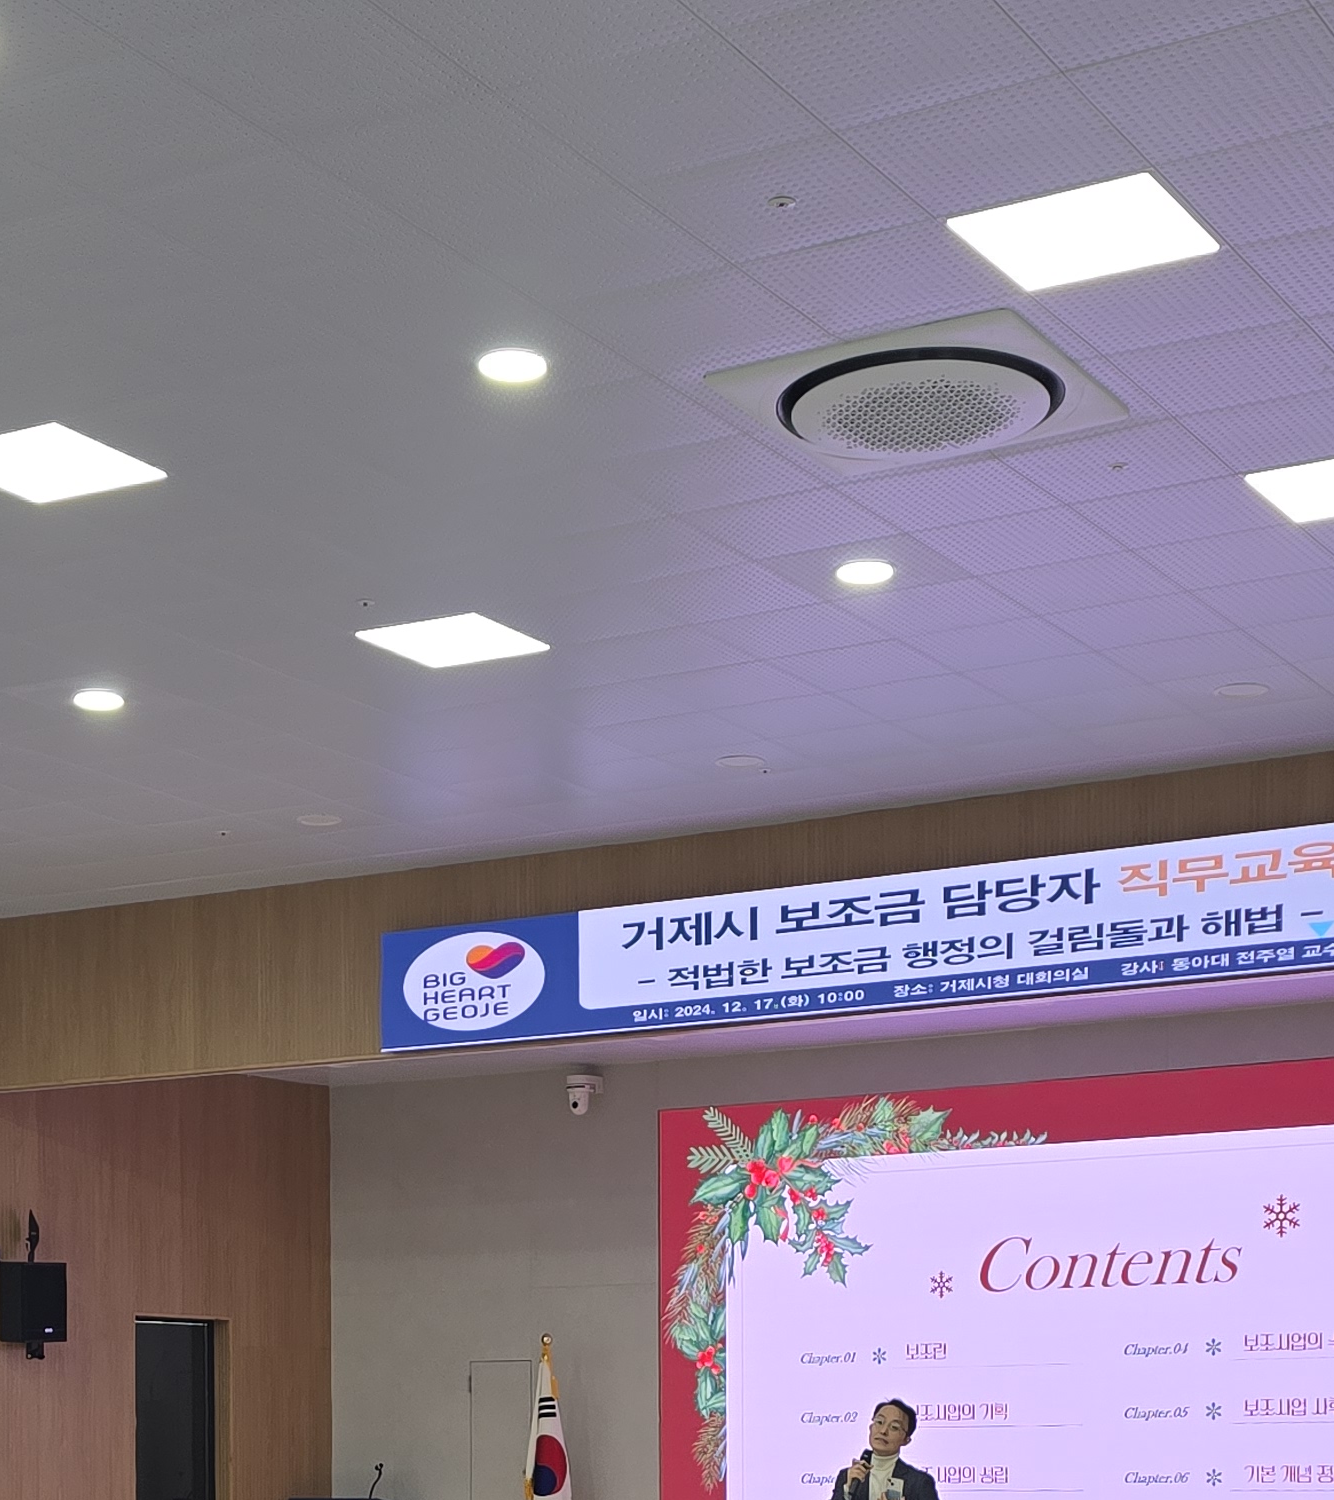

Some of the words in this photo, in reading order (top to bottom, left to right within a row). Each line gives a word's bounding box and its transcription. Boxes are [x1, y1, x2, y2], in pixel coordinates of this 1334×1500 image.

[621, 906, 759, 950] 거제시
[775, 888, 926, 935] 보조금
[943, 867, 1101, 919] 담당자
[667, 958, 772, 991] 적법한
[780, 946, 891, 980] 보조금
[902, 933, 1014, 969] 행정의
[1028, 914, 1190, 956] 걸림돌과
[1201, 903, 1283, 937] 해법
[423, 972, 466, 989] BIG
[423, 984, 511, 1005] HEART
[633, 1008, 669, 1022] 일시:
[674, 1003, 716, 1018] 2024.
[817, 989, 865, 1004] 10:00
[940, 974, 1010, 993] 거제시청
[1017, 967, 1089, 986] 대회의실
[1171, 952, 1229, 971] 동아대
[423, 1001, 509, 1022] GEOJE
[979, 1236, 1243, 1293] Contents
